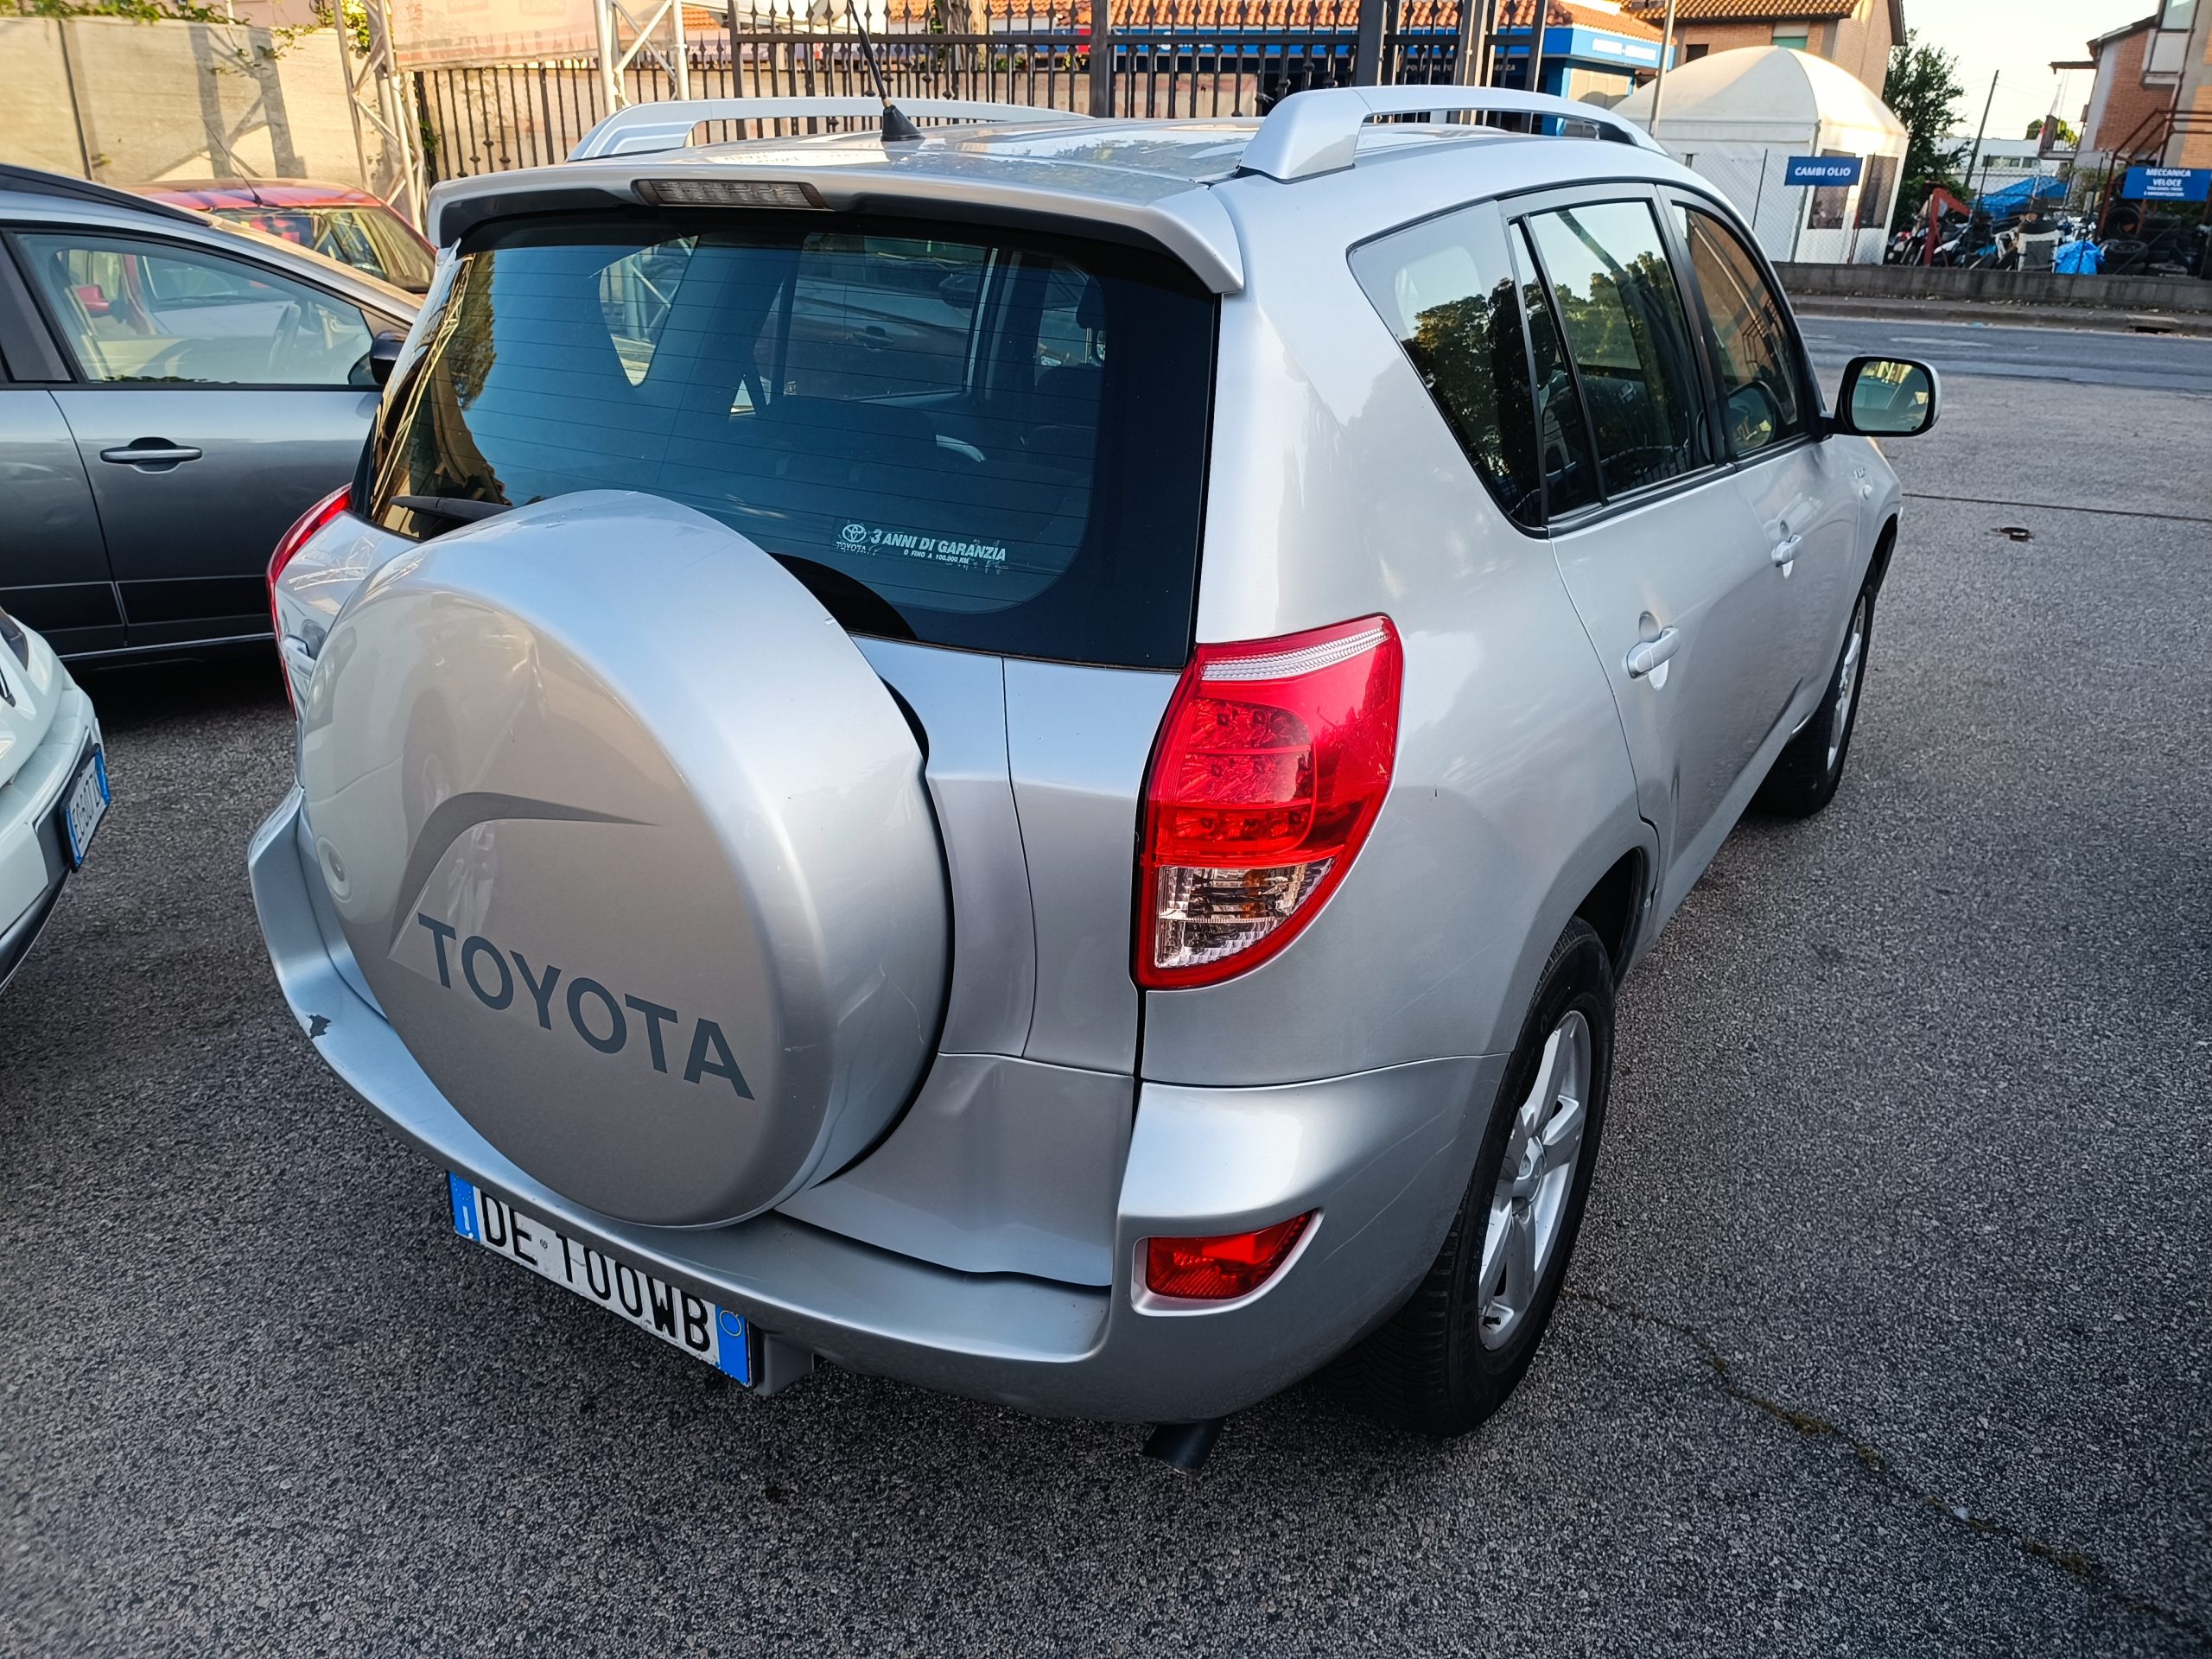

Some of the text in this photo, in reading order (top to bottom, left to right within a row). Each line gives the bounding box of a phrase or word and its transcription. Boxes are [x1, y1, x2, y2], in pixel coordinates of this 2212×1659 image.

[1795, 166, 1852, 177] CAMBI OLIO
[2145, 168, 2191, 178] MECCANICA
[2152, 178, 2183, 187] VELOCE
[836, 541, 867, 554] TOYOTA
[870, 529, 1007, 562] 3 ANNI DI GARANZIA
[911, 550, 925, 558] FINO
[935, 554, 958, 563] 100.000
[417, 912, 755, 1101] TOYOTA
[480, 1191, 539, 1268] DE
